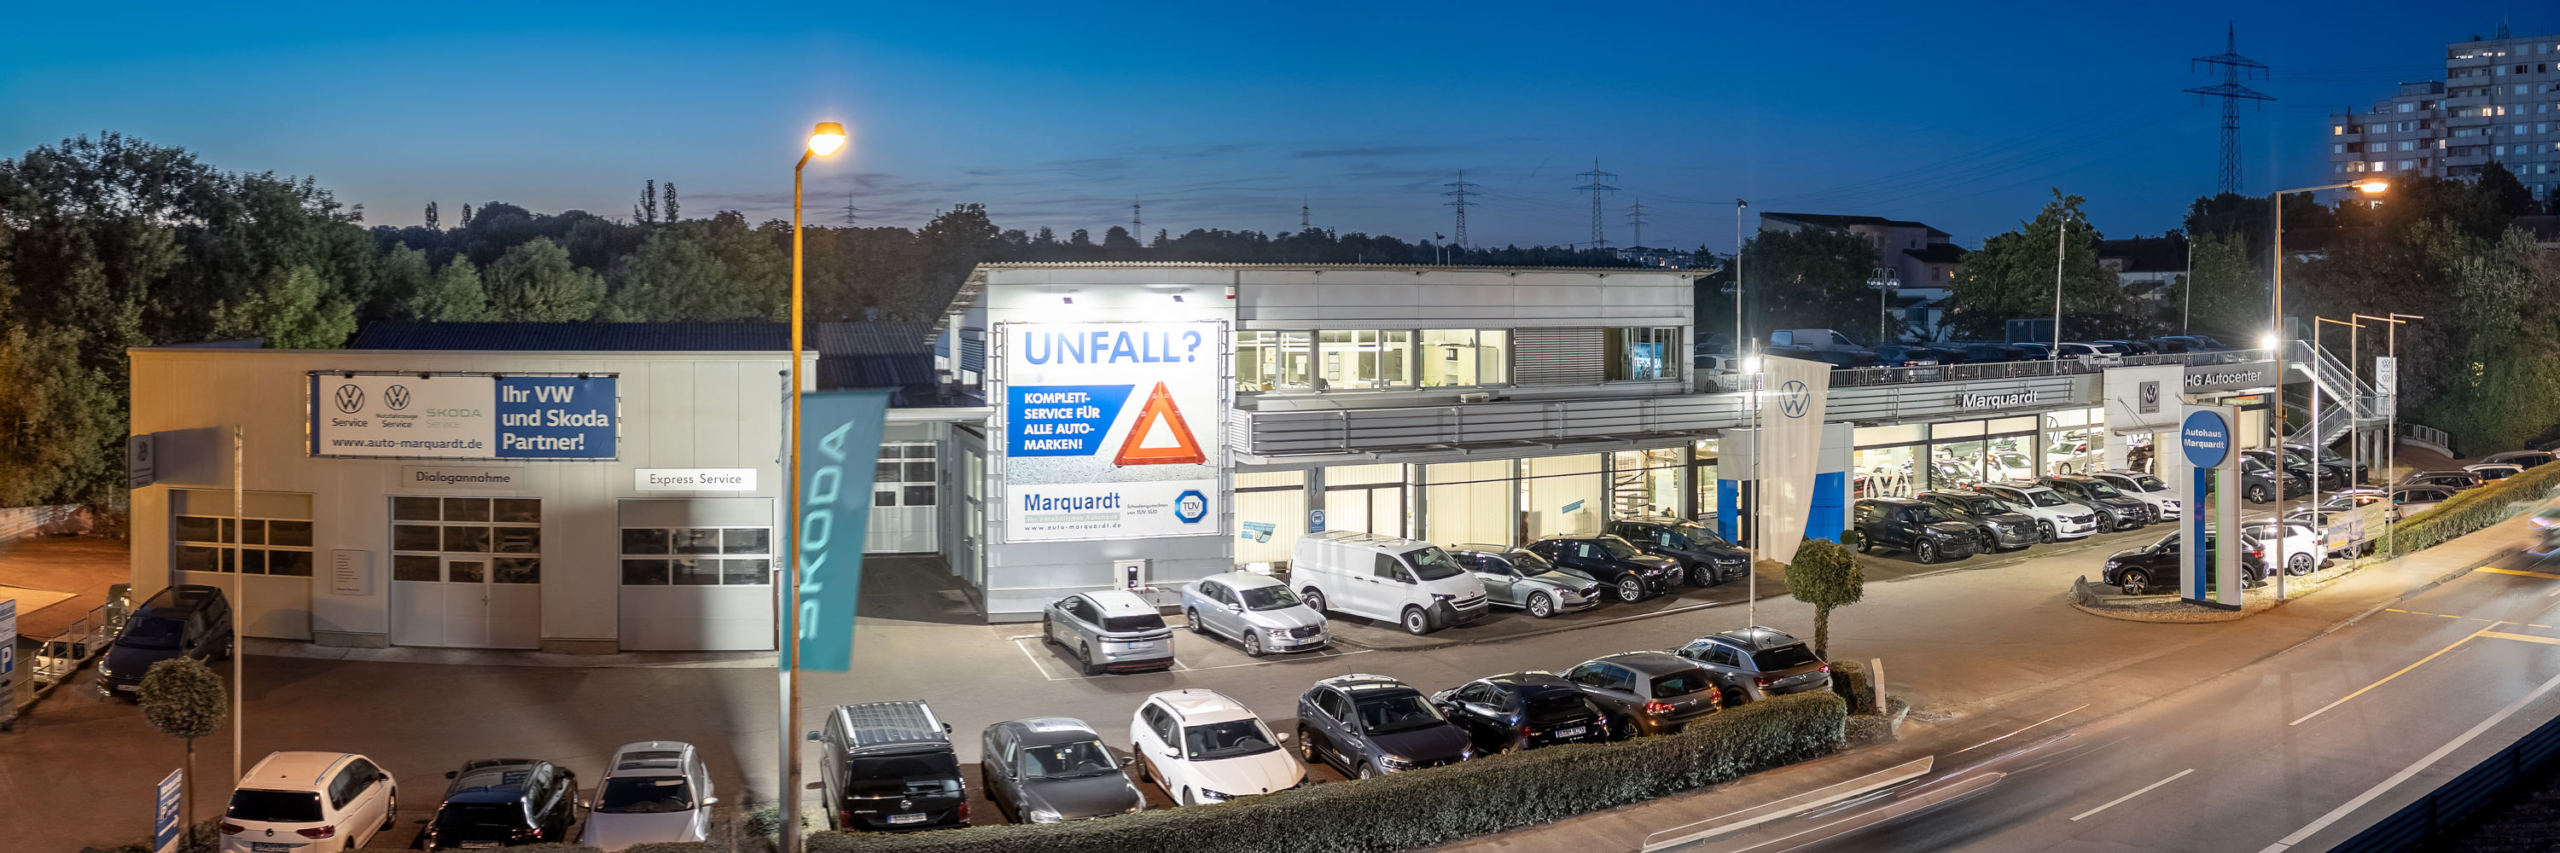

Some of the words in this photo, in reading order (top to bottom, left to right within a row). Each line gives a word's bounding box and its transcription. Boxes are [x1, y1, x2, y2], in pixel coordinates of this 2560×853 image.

[1025, 330, 1202, 365] UNFALL?
[2185, 374, 2202, 387] HG
[2204, 370, 2262, 386] Autocenter
[502, 385, 530, 403] Ihr
[534, 385, 575, 403] VW
[1024, 392, 1091, 404] KOMPLETT-
[1962, 390, 2038, 409] Marquardt
[502, 409, 542, 427] und
[546, 409, 610, 427] Skoda
[1024, 407, 1073, 420] SERVICE
[1076, 405, 1100, 419] FÜR
[331, 418, 368, 427] Service
[381, 420, 413, 428] Service
[425, 420, 461, 428] Service
[1024, 424, 1053, 435] ALLE
[1055, 422, 1095, 434] AUTO-
[2185, 428, 2222, 438] Autohaus
[331, 438, 483, 450] www.auto-marquardt.de
[502, 432, 586, 451] Partner!
[1024, 438, 1083, 450] MARKEN!
[2183, 438, 2225, 449] Marquardt
[416, 471, 511, 485] Dialogannahme
[650, 473, 694, 486] Express
[699, 473, 742, 484] Service
[1024, 492, 1121, 513] Marquardt
[1024, 522, 1122, 531] www.auto-marquardt.de
